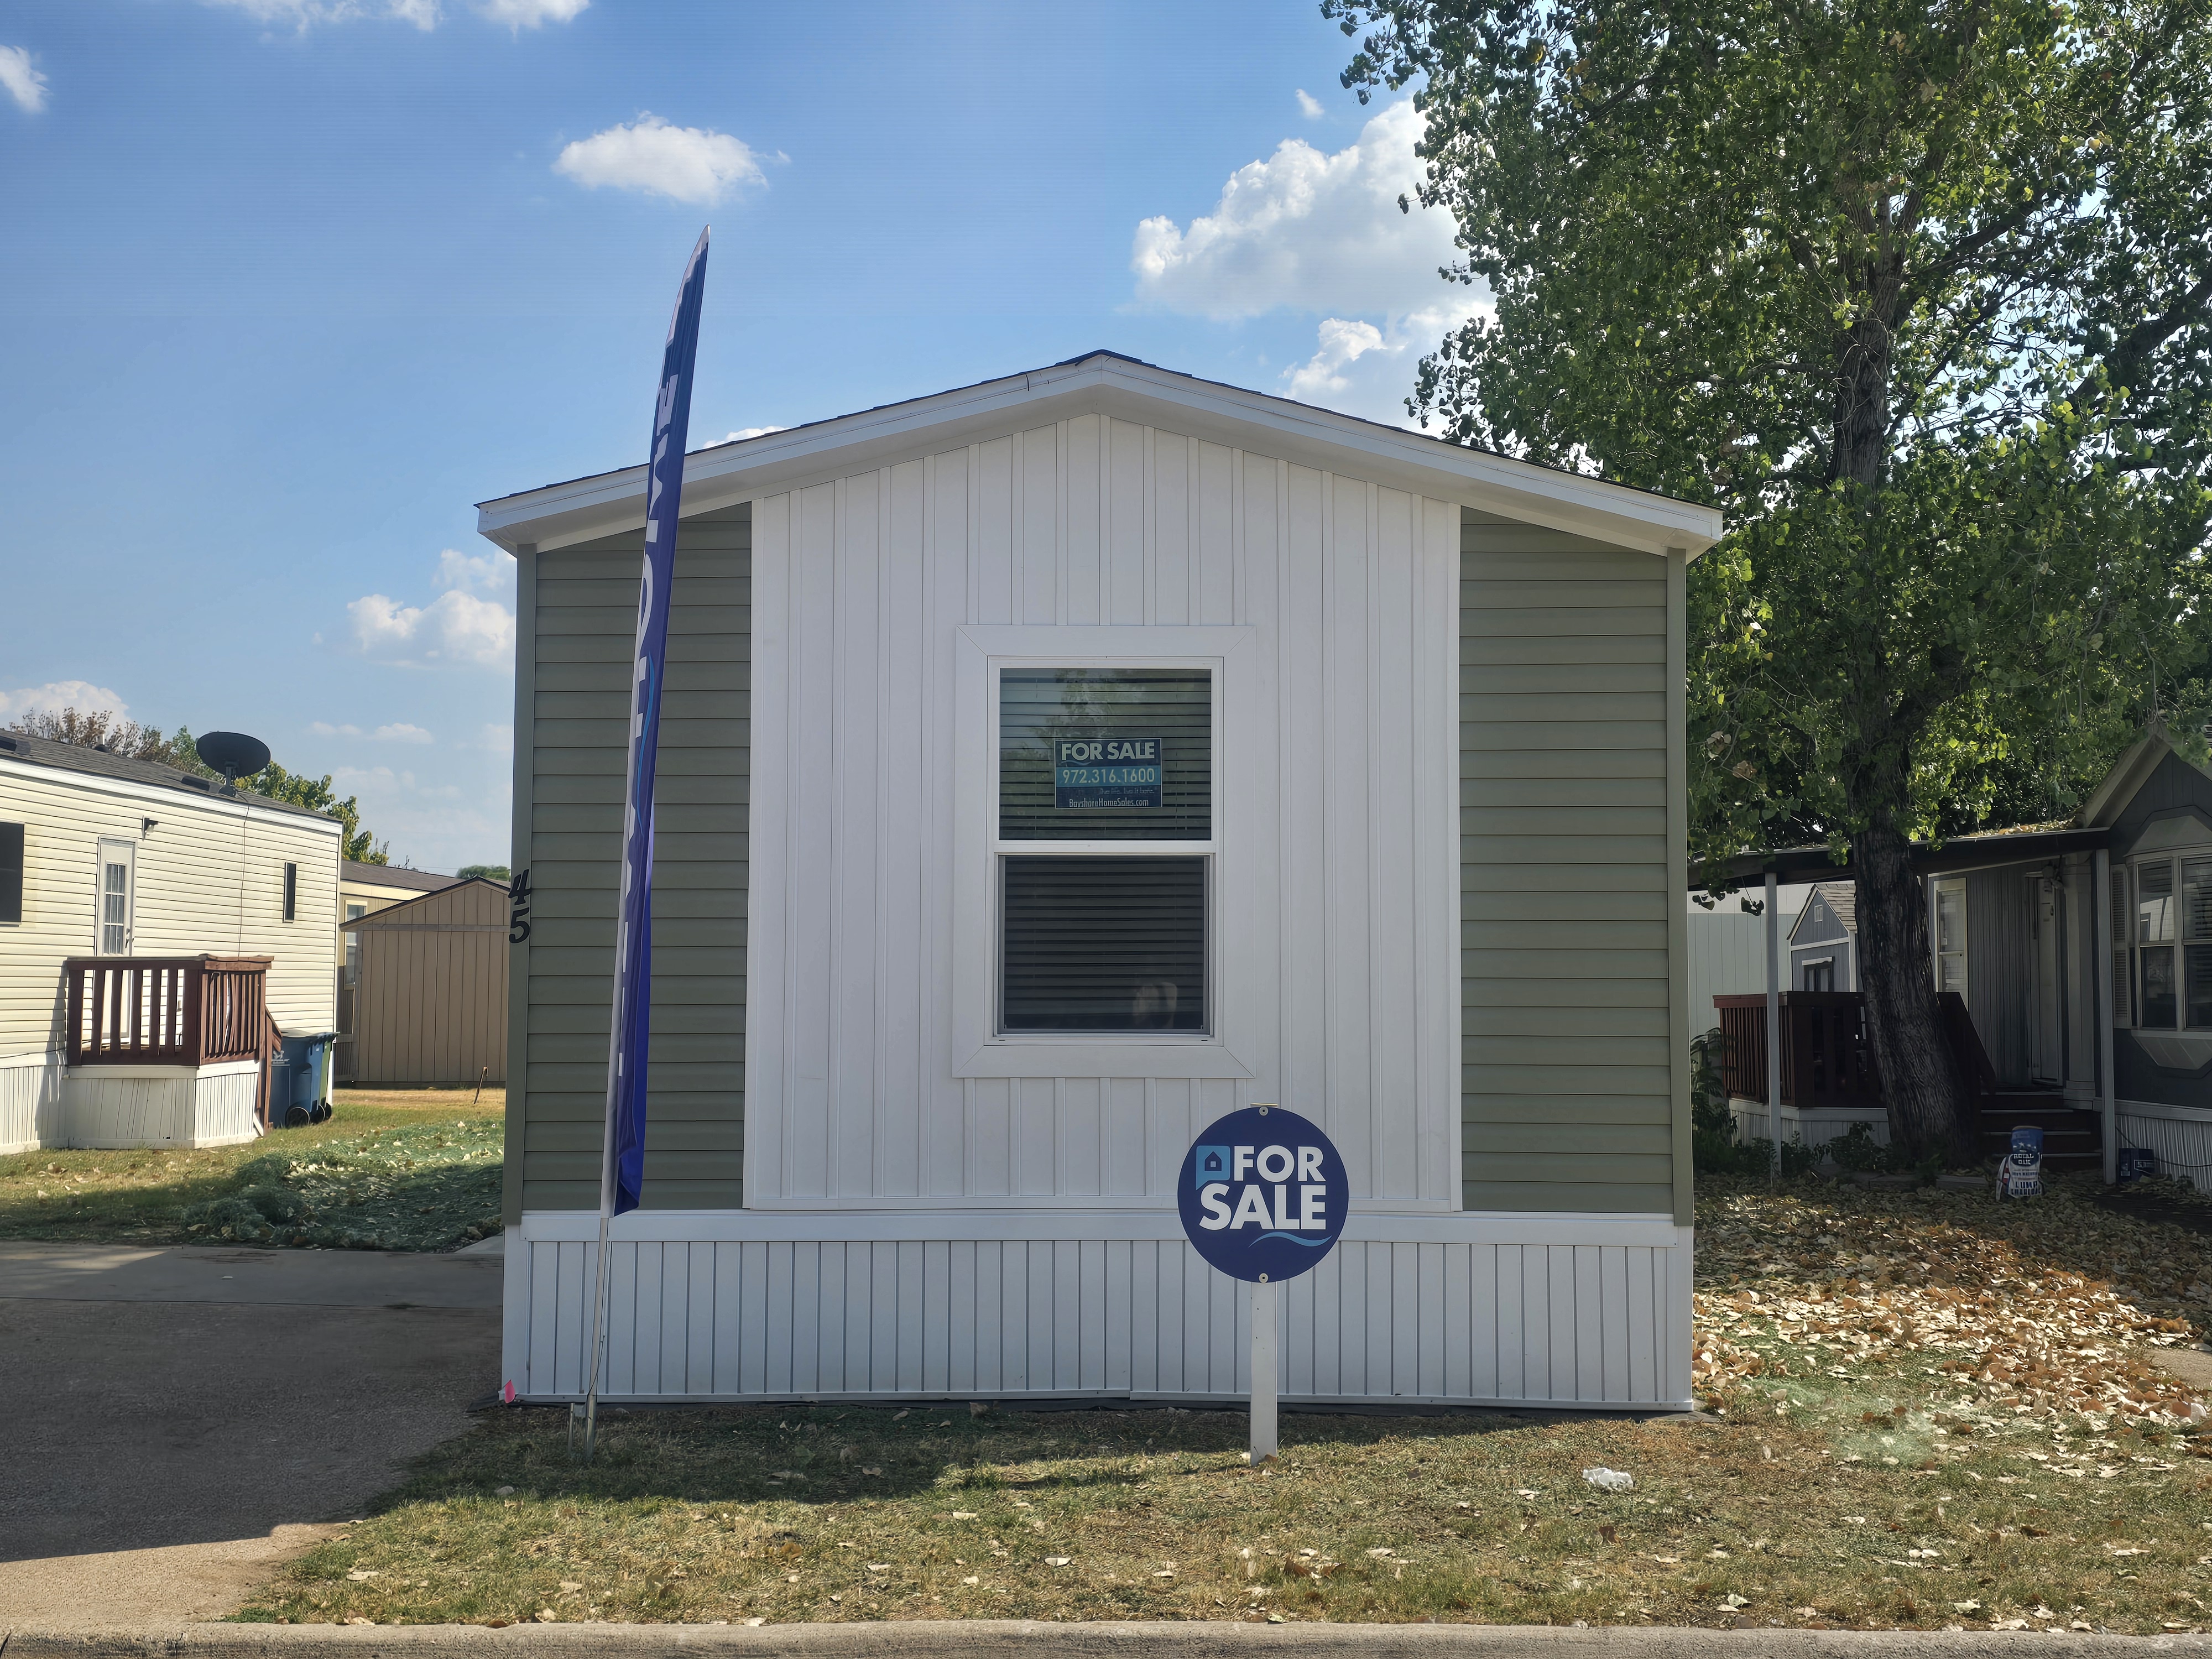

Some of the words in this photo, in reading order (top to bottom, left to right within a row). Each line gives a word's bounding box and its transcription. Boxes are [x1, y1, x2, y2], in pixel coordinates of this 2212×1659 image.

[1061, 743, 1103, 760] FOR
[1107, 742, 1155, 759] SALE
[1062, 768, 1155, 784] 972.316.1600
[508, 869, 531, 944] 45
[1234, 1145, 1326, 1182] FOR
[1199, 1183, 1326, 1230] SALE
